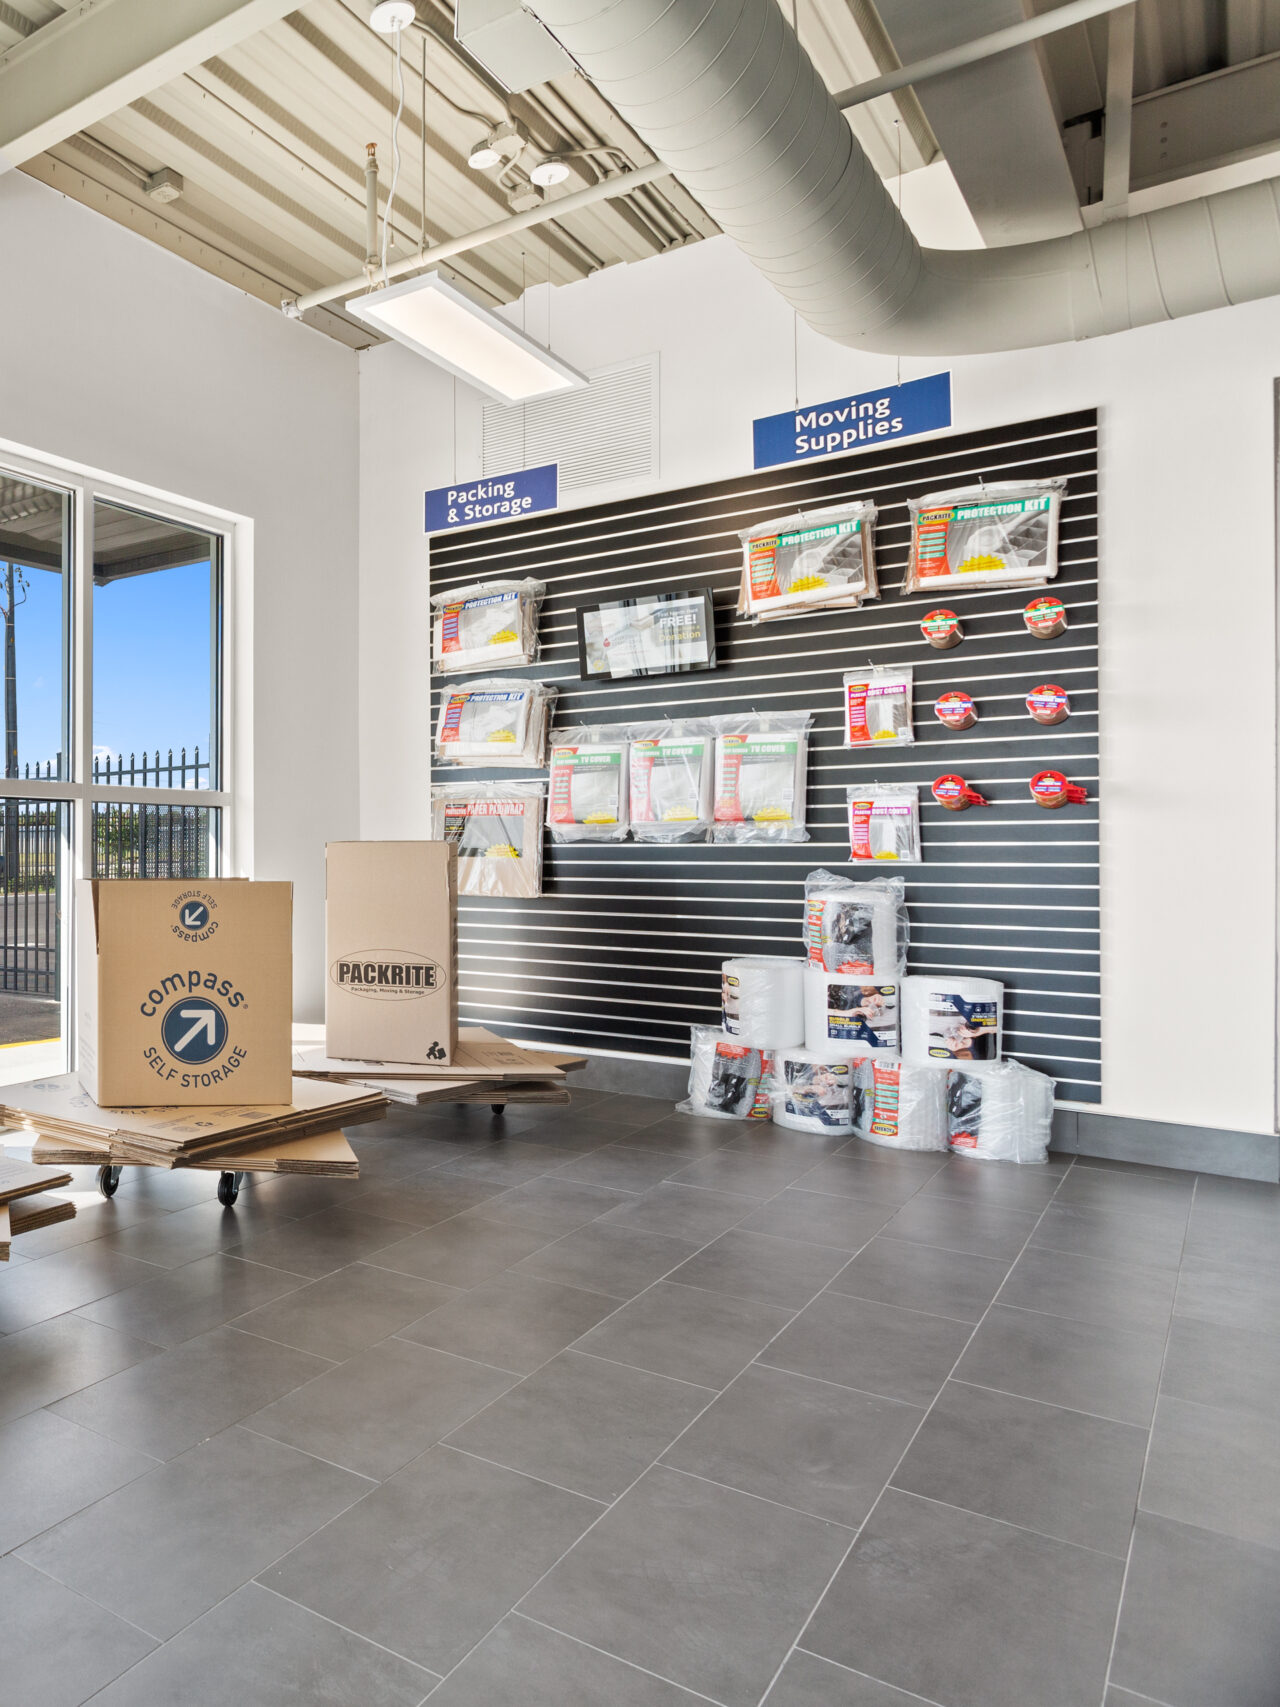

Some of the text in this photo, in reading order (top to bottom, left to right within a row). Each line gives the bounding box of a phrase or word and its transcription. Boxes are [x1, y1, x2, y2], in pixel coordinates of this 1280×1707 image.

[795, 397, 891, 433] Moving
[795, 417, 903, 454] Supplies
[447, 481, 515, 506] Packing
[447, 496, 532, 523] & Storage
[922, 498, 1047, 522] PACKRITE PROTECTION KIT
[781, 526, 837, 546] PROTECTION
[838, 520, 858, 533] KIT
[465, 595, 503, 610] PROTECTION
[503, 592, 516, 601] KIT
[660, 613, 697, 628] FREE!
[659, 631, 701, 642] Donation
[470, 694, 509, 702] PROTECTION
[508, 693, 522, 701] KIT
[883, 686, 904, 694] COVER
[589, 755, 611, 763] COVER
[467, 803, 488, 816] PAPER
[171, 890, 218, 910] SELF STORAGE
[172, 921, 219, 943] compass
[338, 962, 436, 987] PACKRITE
[140, 970, 245, 1018] compass
[143, 1045, 248, 1089] SELF STORAGE
